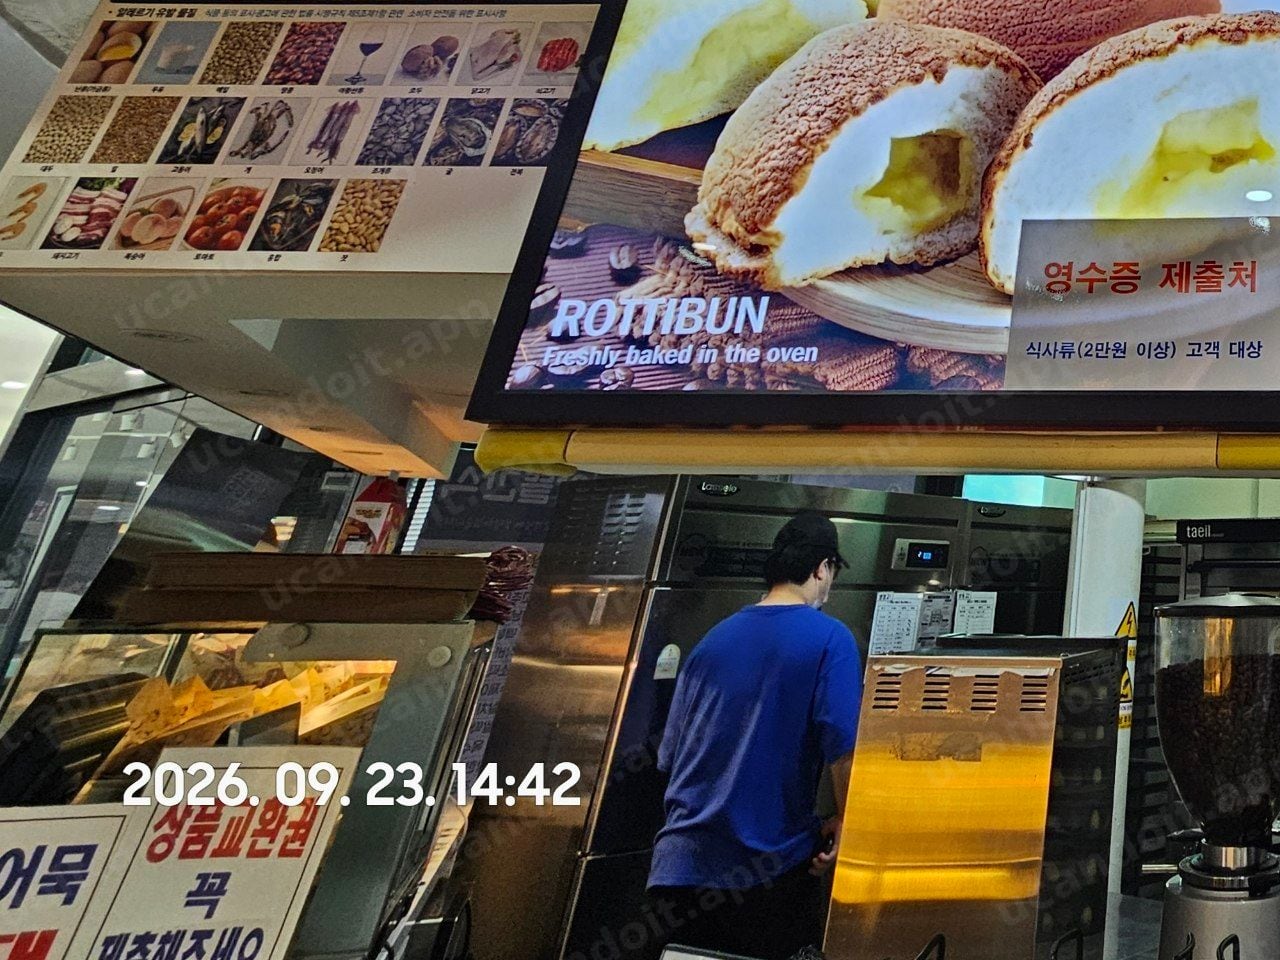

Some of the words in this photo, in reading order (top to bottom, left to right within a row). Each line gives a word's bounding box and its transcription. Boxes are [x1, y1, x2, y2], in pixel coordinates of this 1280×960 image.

[116, 7, 154, 18] 알레르기
[155, 7, 177, 18] 유발
[177, 7, 199, 18] 물질
[1044, 260, 1142, 295] 영수증
[1159, 259, 1258, 294] 제출처
[551, 296, 770, 338] ROTTIBUN
[542, 346, 619, 368] Freshly
[625, 344, 694, 365] baked
[700, 344, 719, 364] in
[725, 344, 760, 364] the
[766, 346, 819, 363] oven
[1026, 341, 1127, 359] 식사류(2만원
[1137, 341, 1177, 359] 이상)
[1186, 341, 1220, 358] 고객
[1229, 341, 1263, 358] 대상
[146, 795, 320, 864] 상품교환권
[184, 871, 232, 920] 꼭
